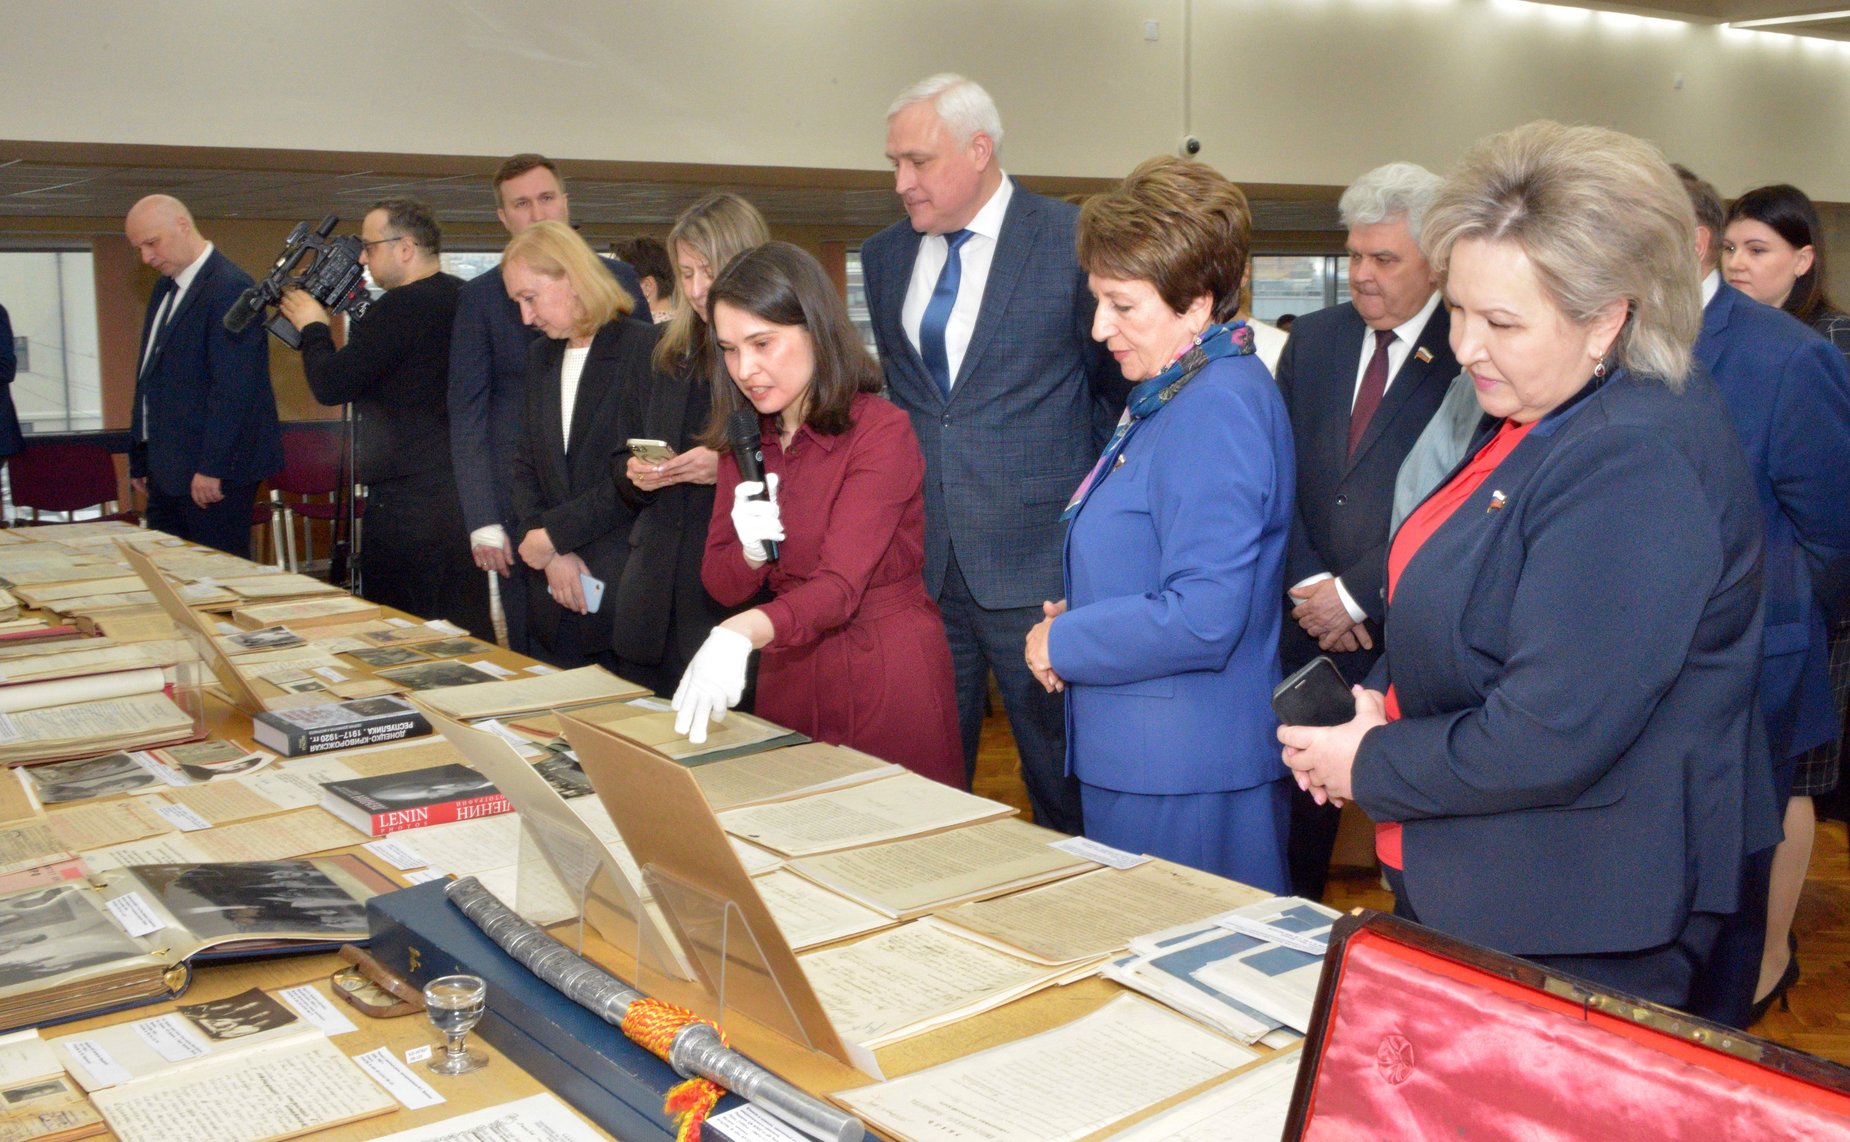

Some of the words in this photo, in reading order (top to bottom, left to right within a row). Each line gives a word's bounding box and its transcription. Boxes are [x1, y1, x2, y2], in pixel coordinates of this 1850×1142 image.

[310, 729, 407, 753] ДОНЕЦКО-КРИВОРОЖСКАЯ
[456, 795, 506, 807] ОТОГРАФИИ
[379, 807, 429, 828] LENIN
[380, 821, 429, 834] PHOTOS
